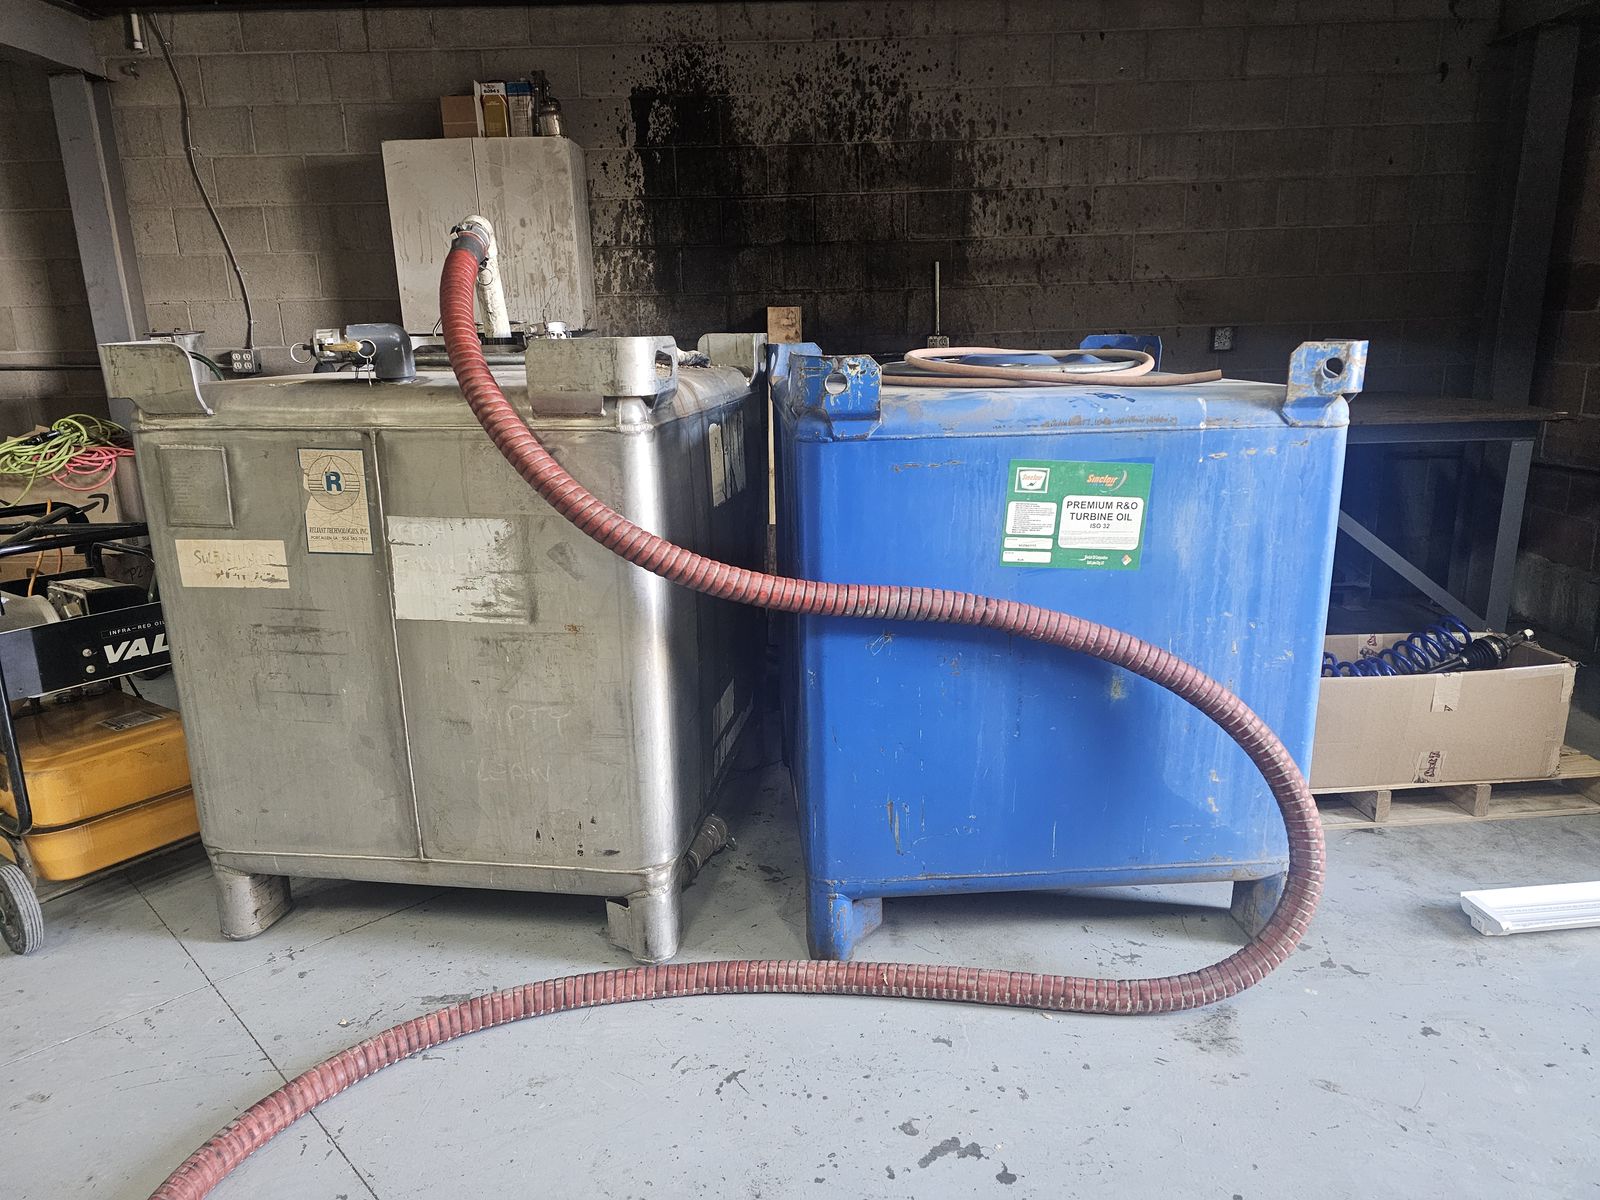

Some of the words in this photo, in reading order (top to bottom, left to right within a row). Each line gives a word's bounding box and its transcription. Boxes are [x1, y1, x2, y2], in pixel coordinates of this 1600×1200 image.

[325, 471, 342, 492] R
[1066, 500, 1114, 510] PREMIUM
[1116, 501, 1139, 510] R&O
[1069, 512, 1114, 521] TURBINE
[1116, 513, 1133, 521] OIL
[109, 623, 152, 636] INFRA-RED
